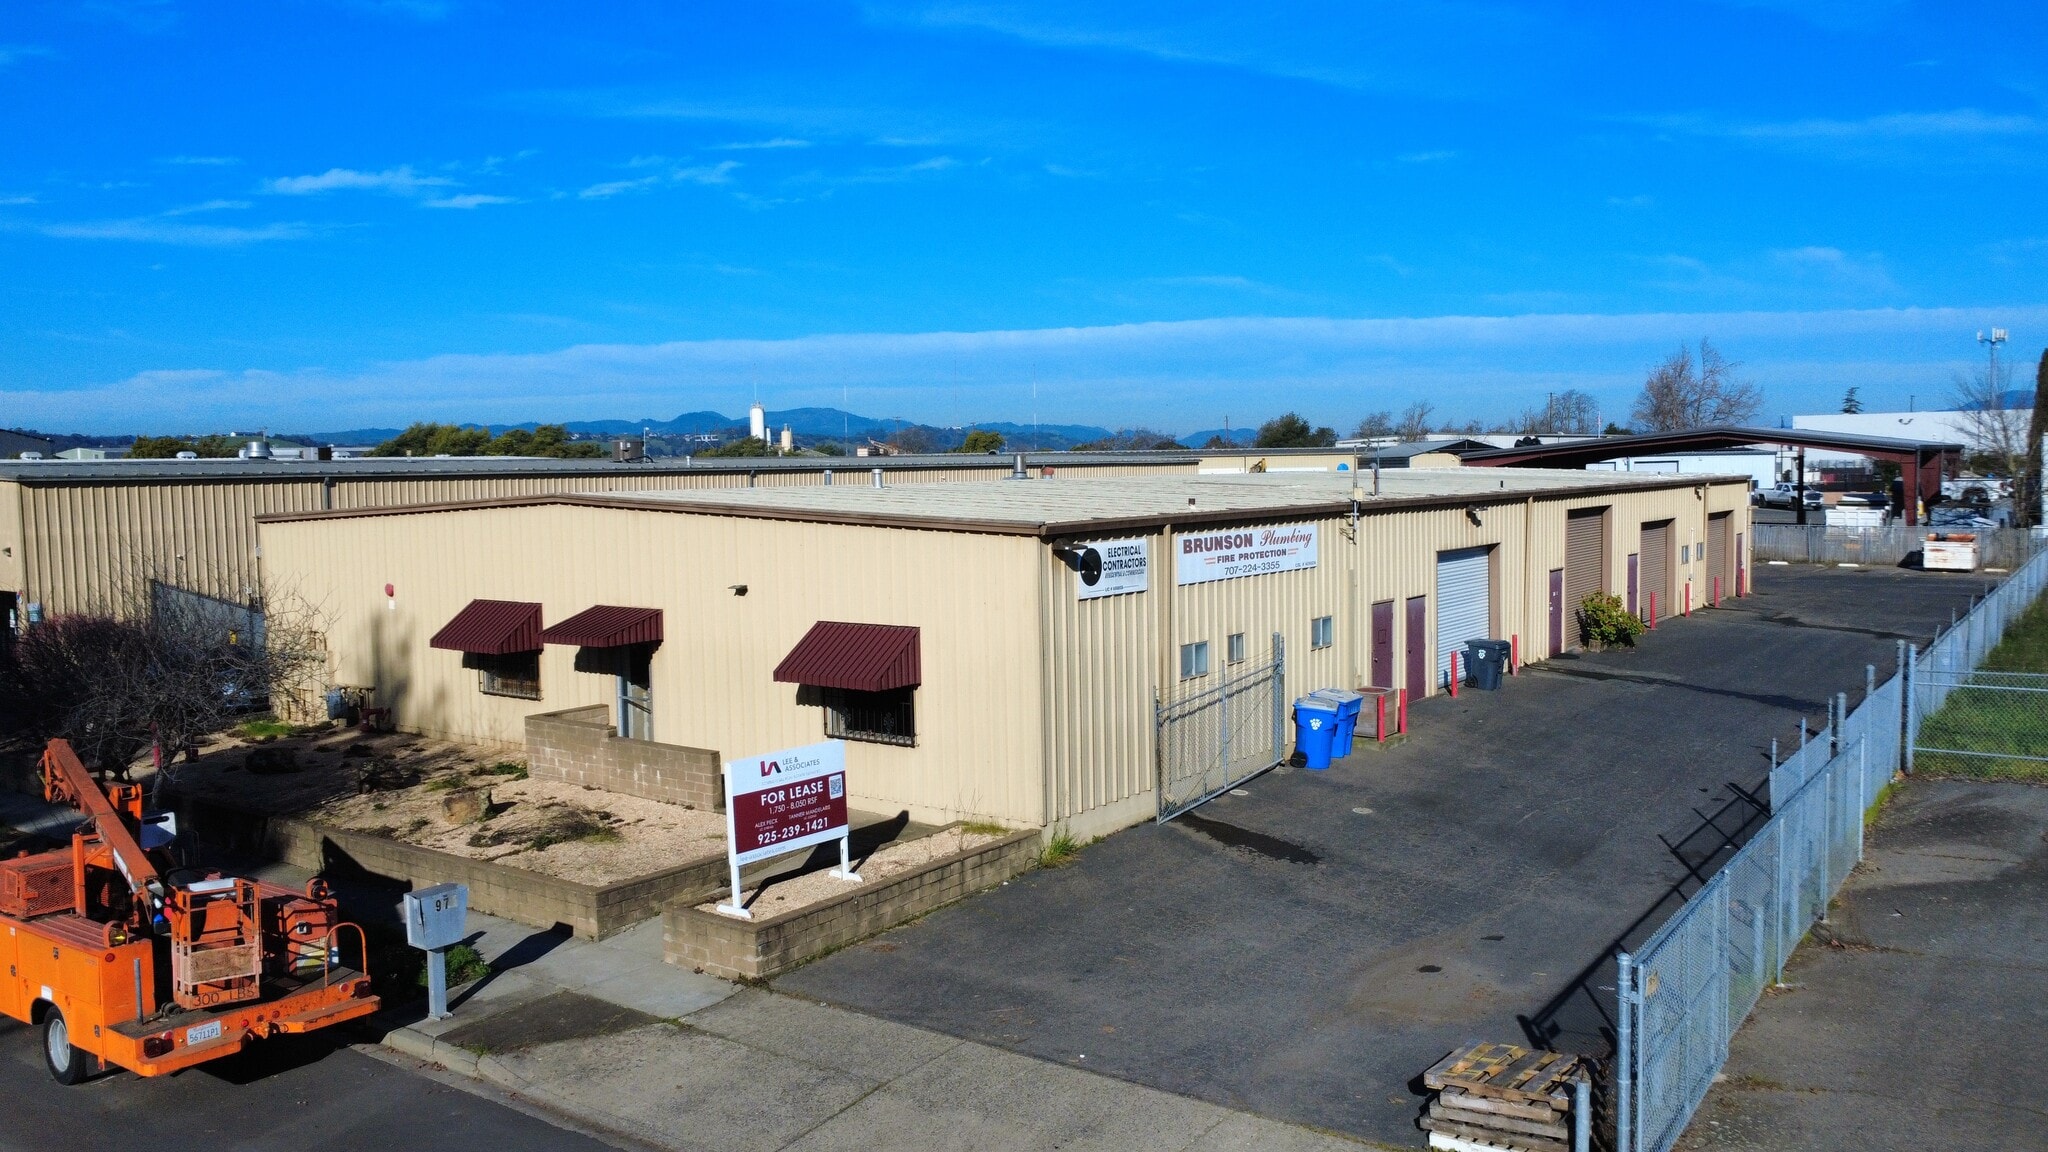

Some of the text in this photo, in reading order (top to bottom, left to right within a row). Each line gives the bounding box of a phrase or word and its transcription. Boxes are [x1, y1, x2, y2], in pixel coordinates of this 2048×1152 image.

[1183, 528, 1312, 554] BRUNSON Plumbing
[1107, 545, 1141, 558] ELECTRICAL
[1217, 549, 1287, 564] FIRE PROTECTION
[1102, 557, 1147, 571] CONTRACTORS
[1224, 561, 1281, 575] 707-224-3355
[782, 758, 793, 766] LEE
[784, 759, 820, 772] ASSOCIATES
[760, 780, 824, 807] FOR LEASE
[769, 804, 786, 815] 1,750
[757, 816, 828, 845] 925-239-1421
[194, 983, 256, 1007] 300 LBS
